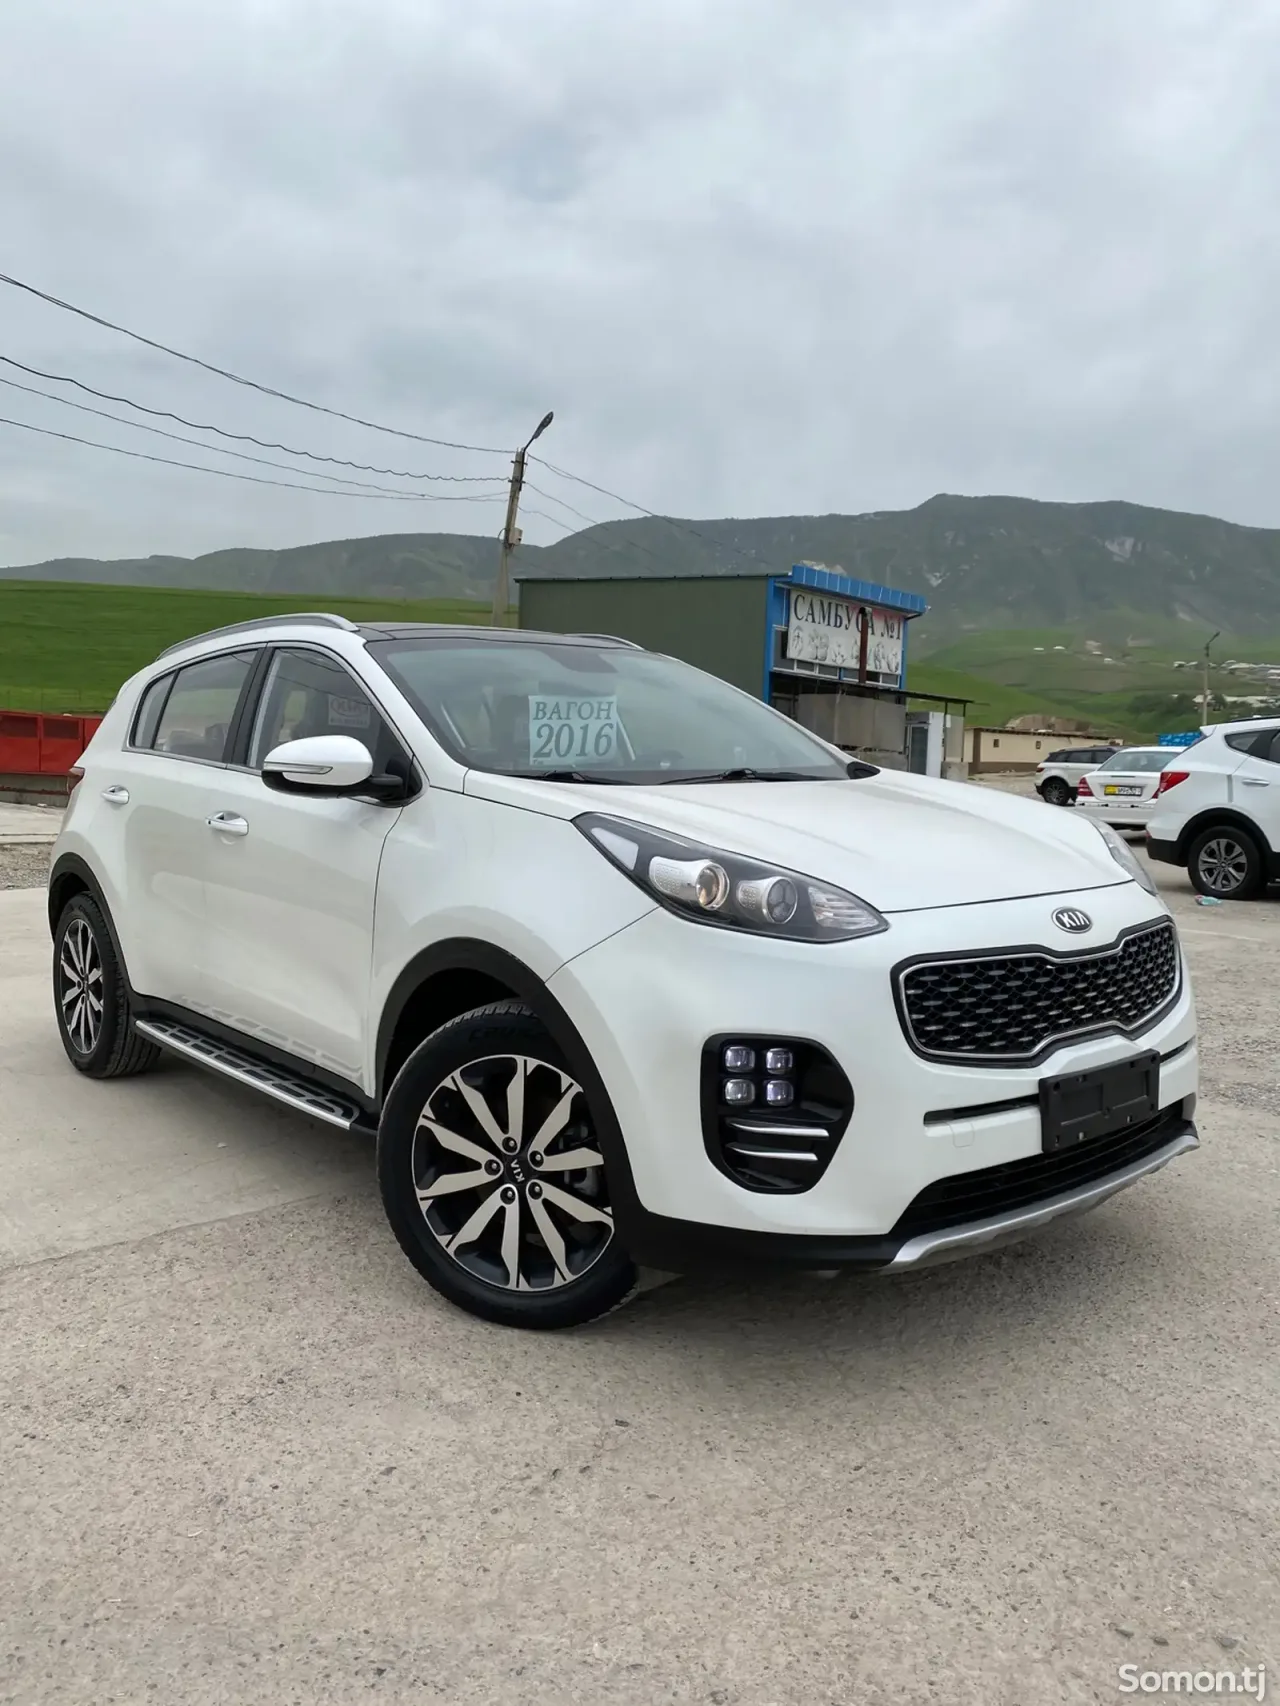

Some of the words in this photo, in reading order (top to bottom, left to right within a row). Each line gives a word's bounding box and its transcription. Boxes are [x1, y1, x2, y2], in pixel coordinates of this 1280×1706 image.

[532, 701, 614, 720] ВАГОН
[532, 722, 614, 758] 2016
[1057, 911, 1090, 928] KIA
[510, 1159, 525, 1182] KIA
